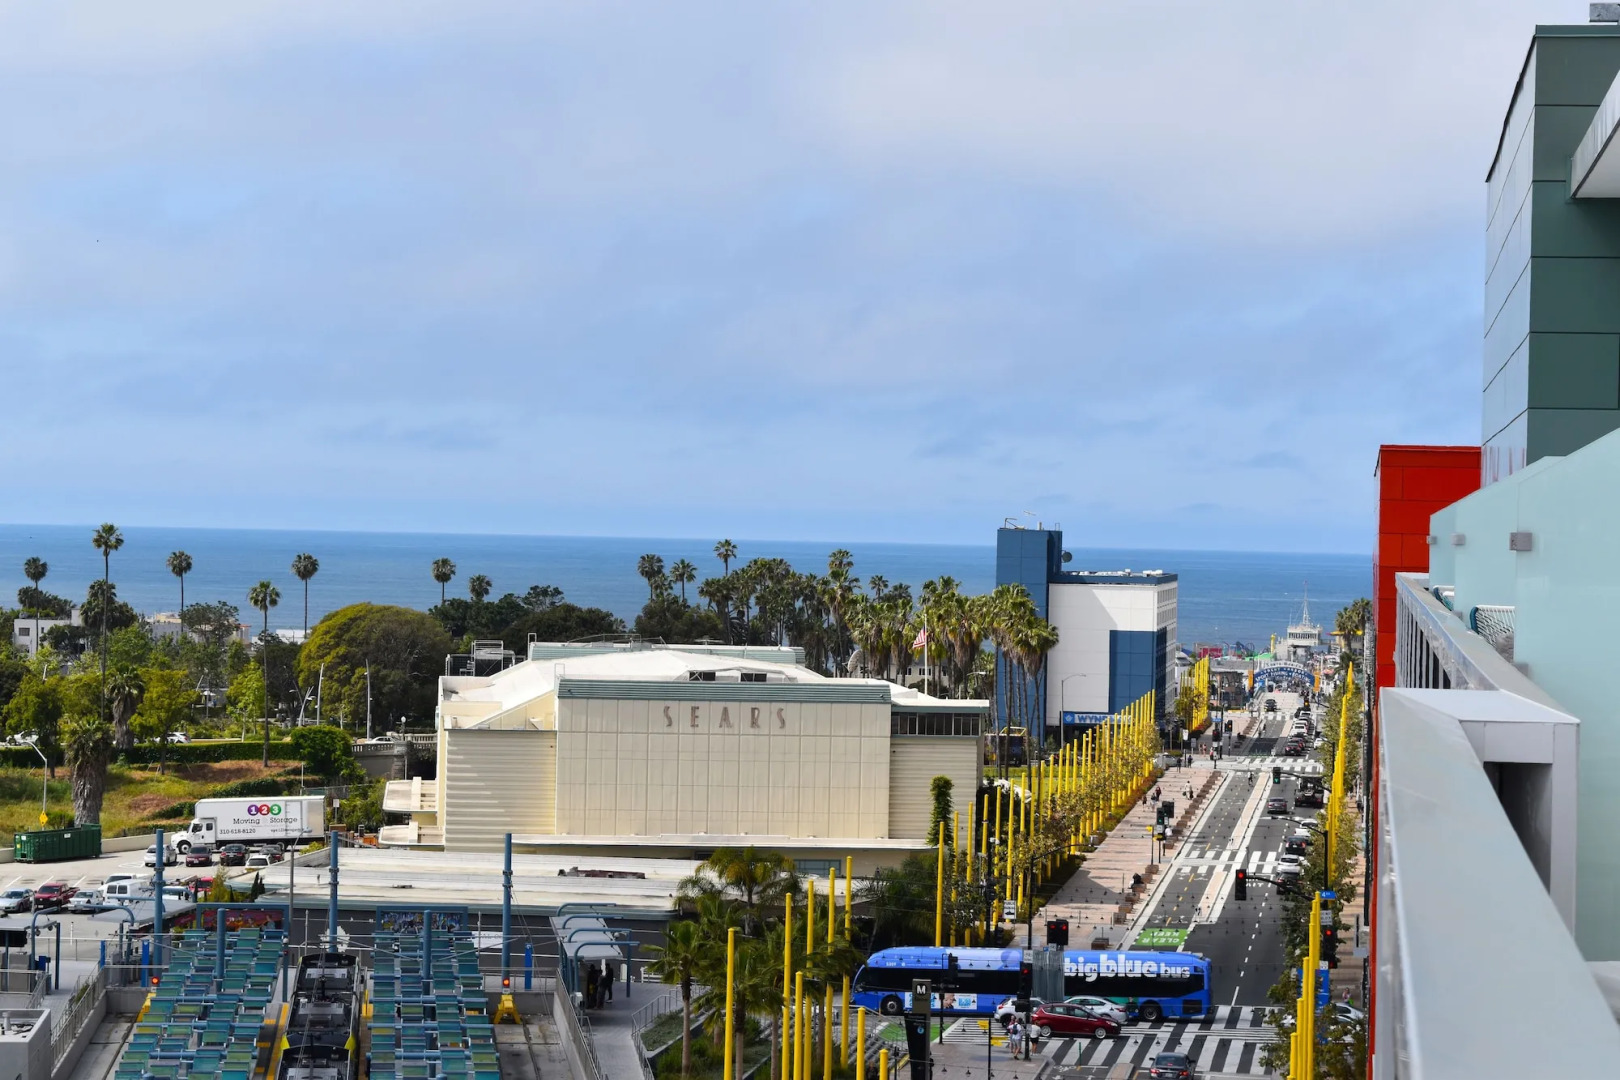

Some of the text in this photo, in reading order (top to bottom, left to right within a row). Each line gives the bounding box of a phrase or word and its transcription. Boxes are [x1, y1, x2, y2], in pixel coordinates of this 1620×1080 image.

[663, 705, 786, 729] SEARS
[1064, 954, 1190, 982] big blue bus
[916, 985, 926, 994] M
